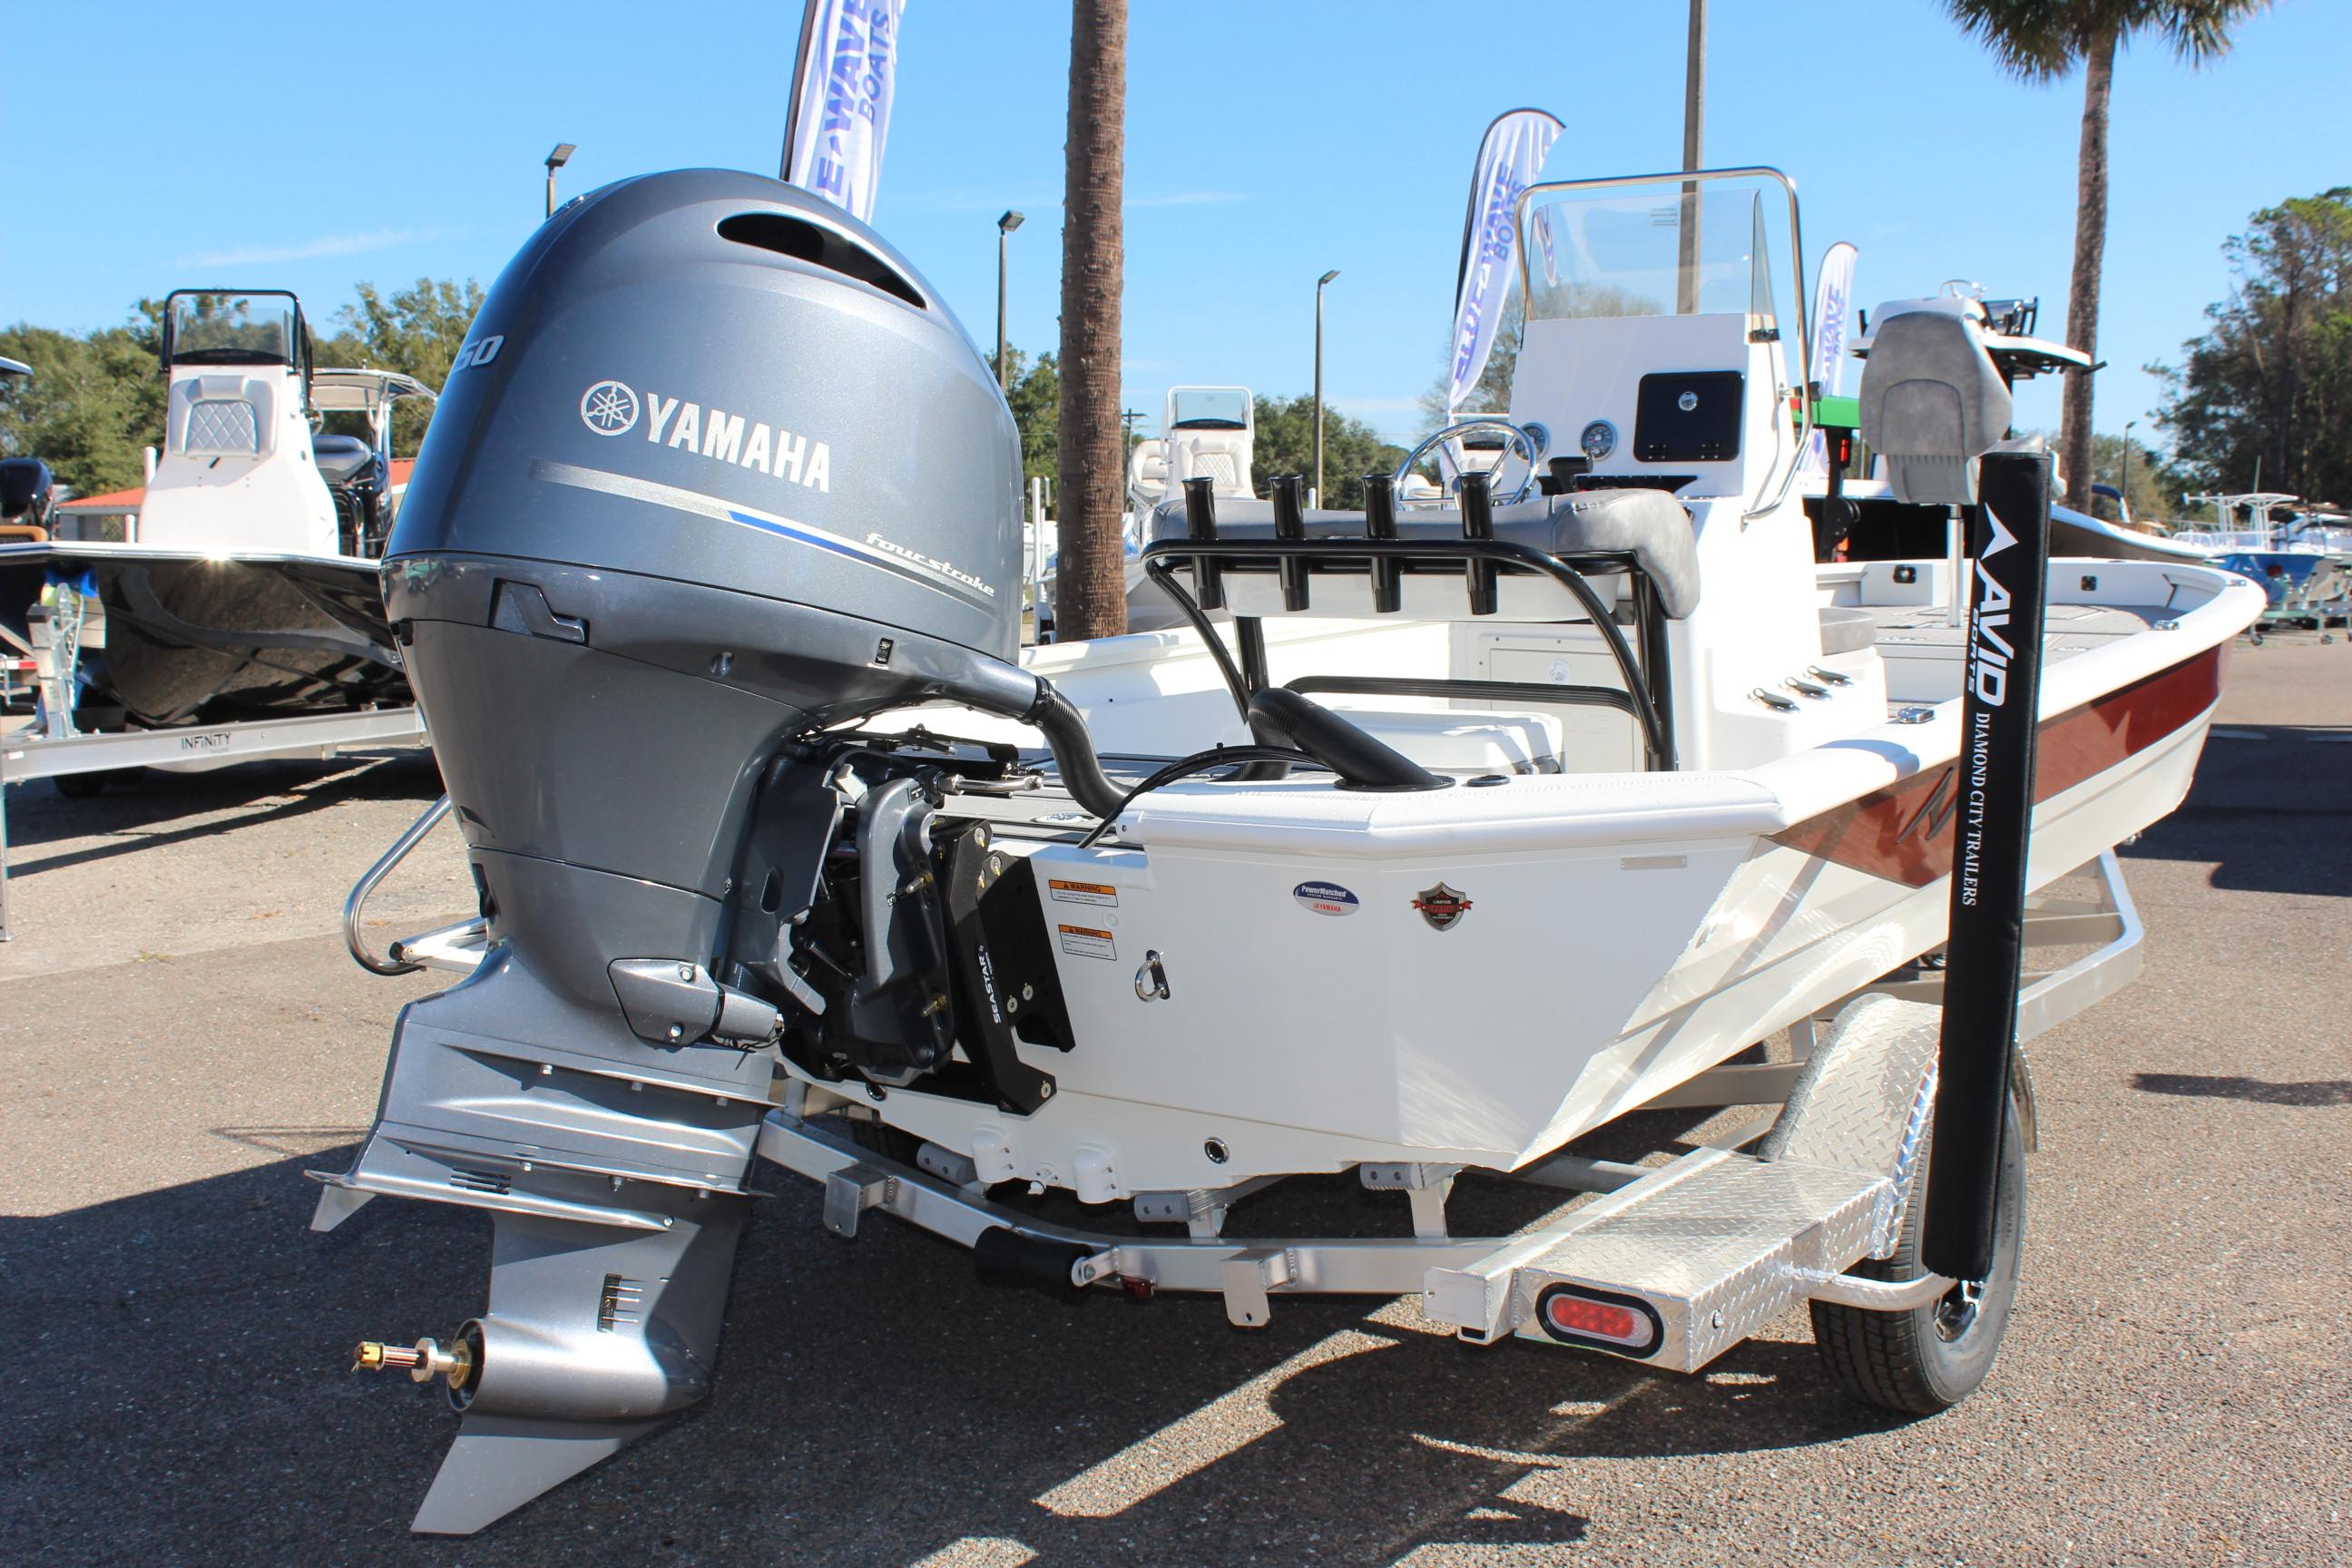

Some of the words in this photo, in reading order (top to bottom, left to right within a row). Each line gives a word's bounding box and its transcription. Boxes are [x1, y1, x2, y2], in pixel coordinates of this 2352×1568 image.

[858, 8, 890, 127] BOATS
[1494, 180, 1528, 262] BOATS
[646, 391, 830, 494] YAMAHA
[1968, 607, 1979, 693] BOATS
[1975, 558, 2014, 707] AVID
[1971, 712, 1991, 788] DIAMOND
[1967, 789, 1985, 828] CITY
[1071, 882, 1102, 892] WARNING
[1301, 885, 1347, 898] PowerMatched
[1962, 829, 1982, 906] TRAILERS
[1319, 904, 1342, 913] YAMAHA
[978, 955, 1002, 1024] SEASTAR
